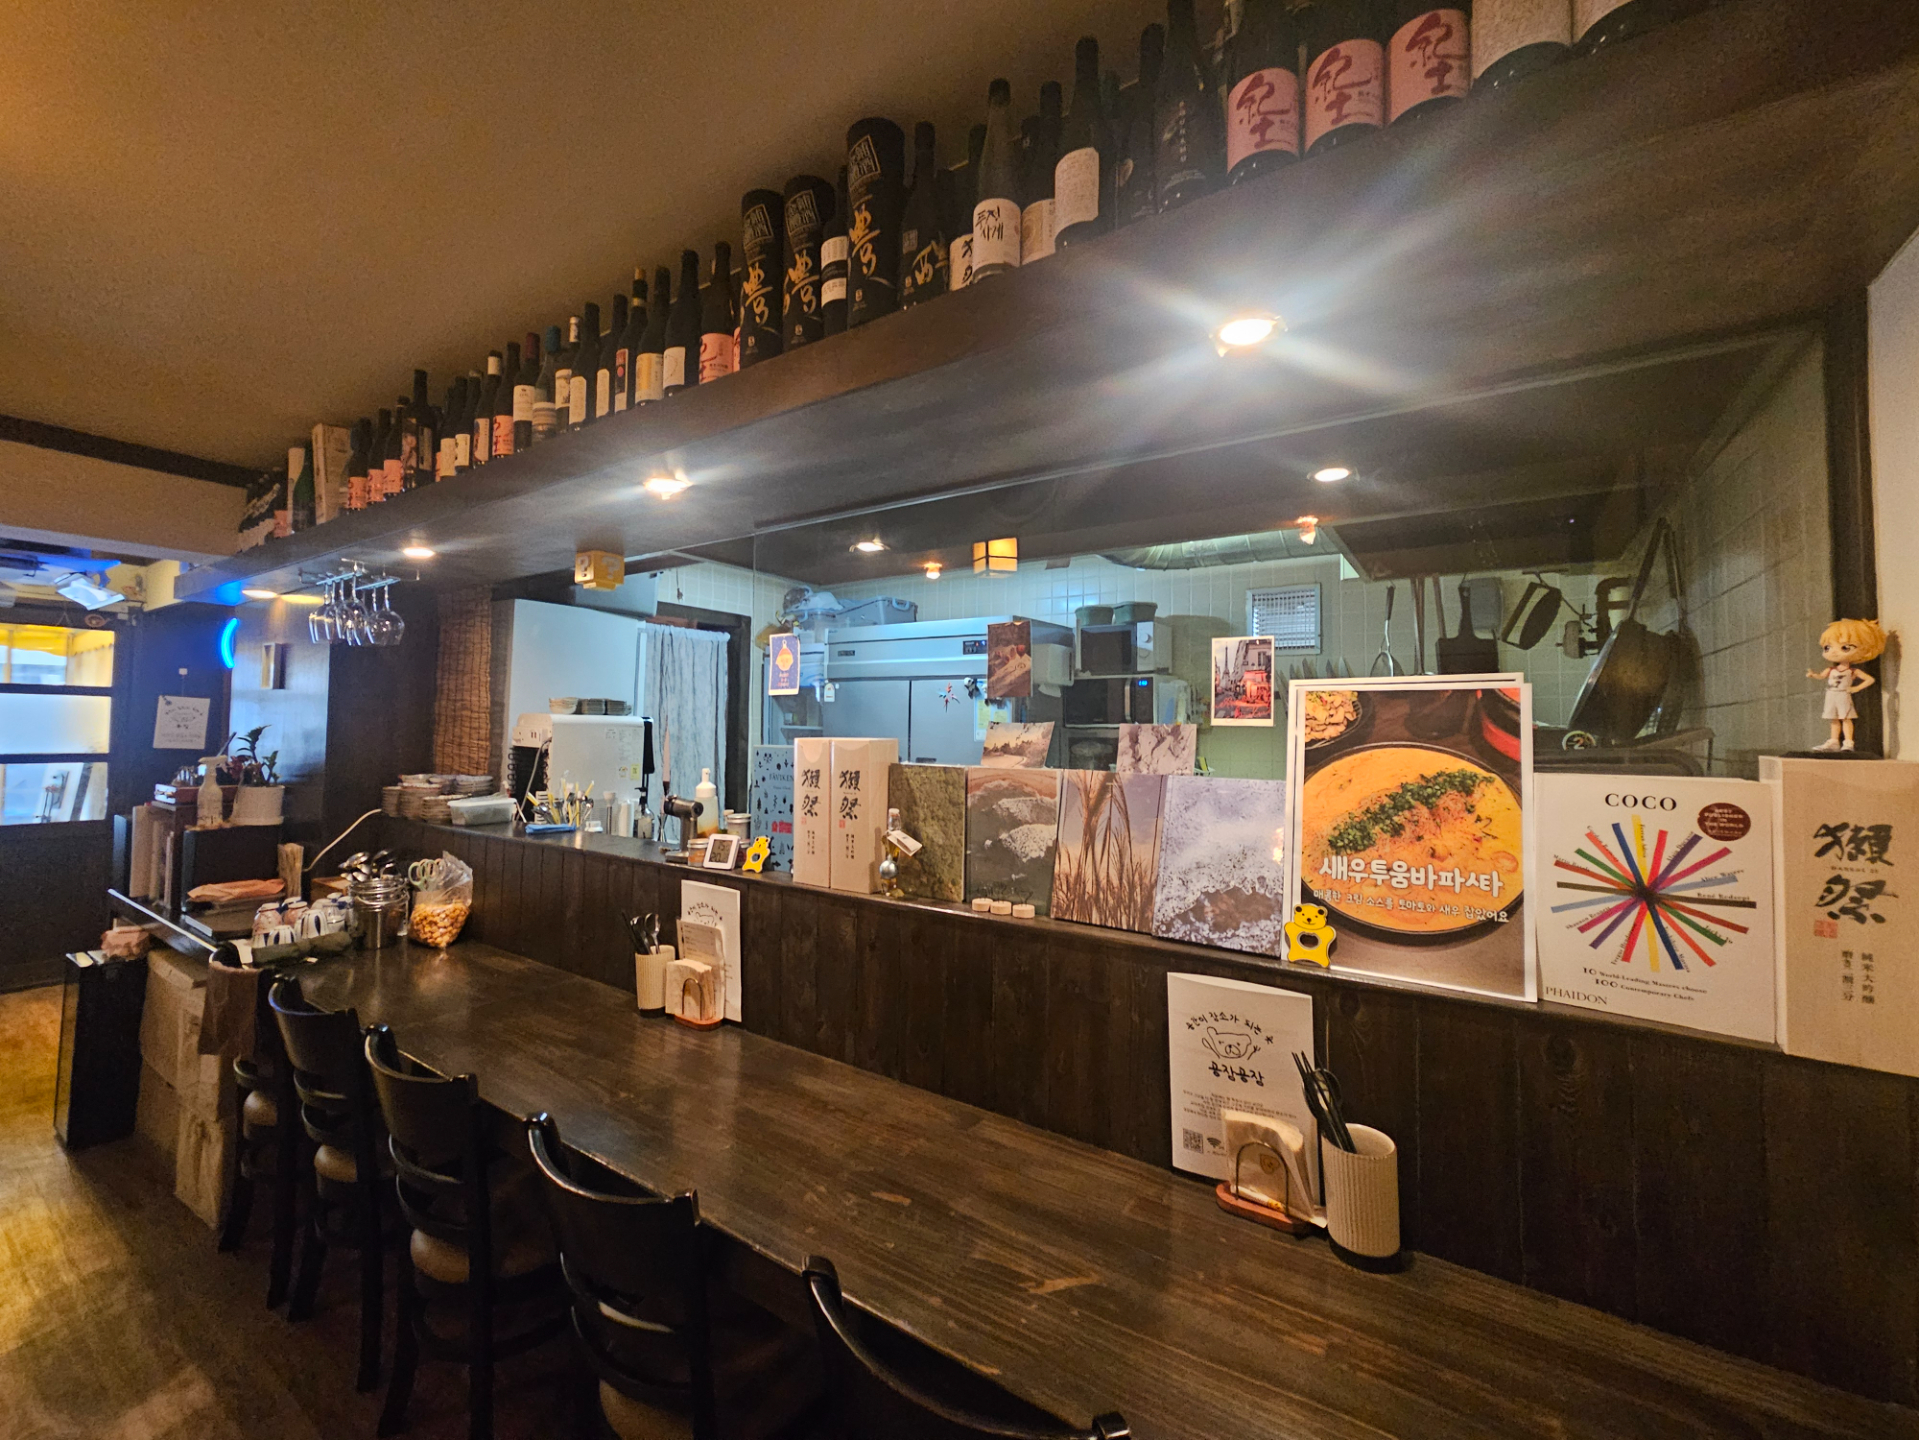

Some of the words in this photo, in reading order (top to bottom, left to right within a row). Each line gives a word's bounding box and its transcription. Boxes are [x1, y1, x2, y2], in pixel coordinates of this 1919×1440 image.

[1604, 793, 1677, 811] COCO
[1365, 897, 1394, 910] 소스를
[1398, 899, 1436, 913] 토마토와
[1439, 904, 1461, 916] 새우
[1583, 966, 1597, 976] 10
[1594, 978, 1618, 988] 100
[1545, 986, 1608, 1005] PHAIDON
